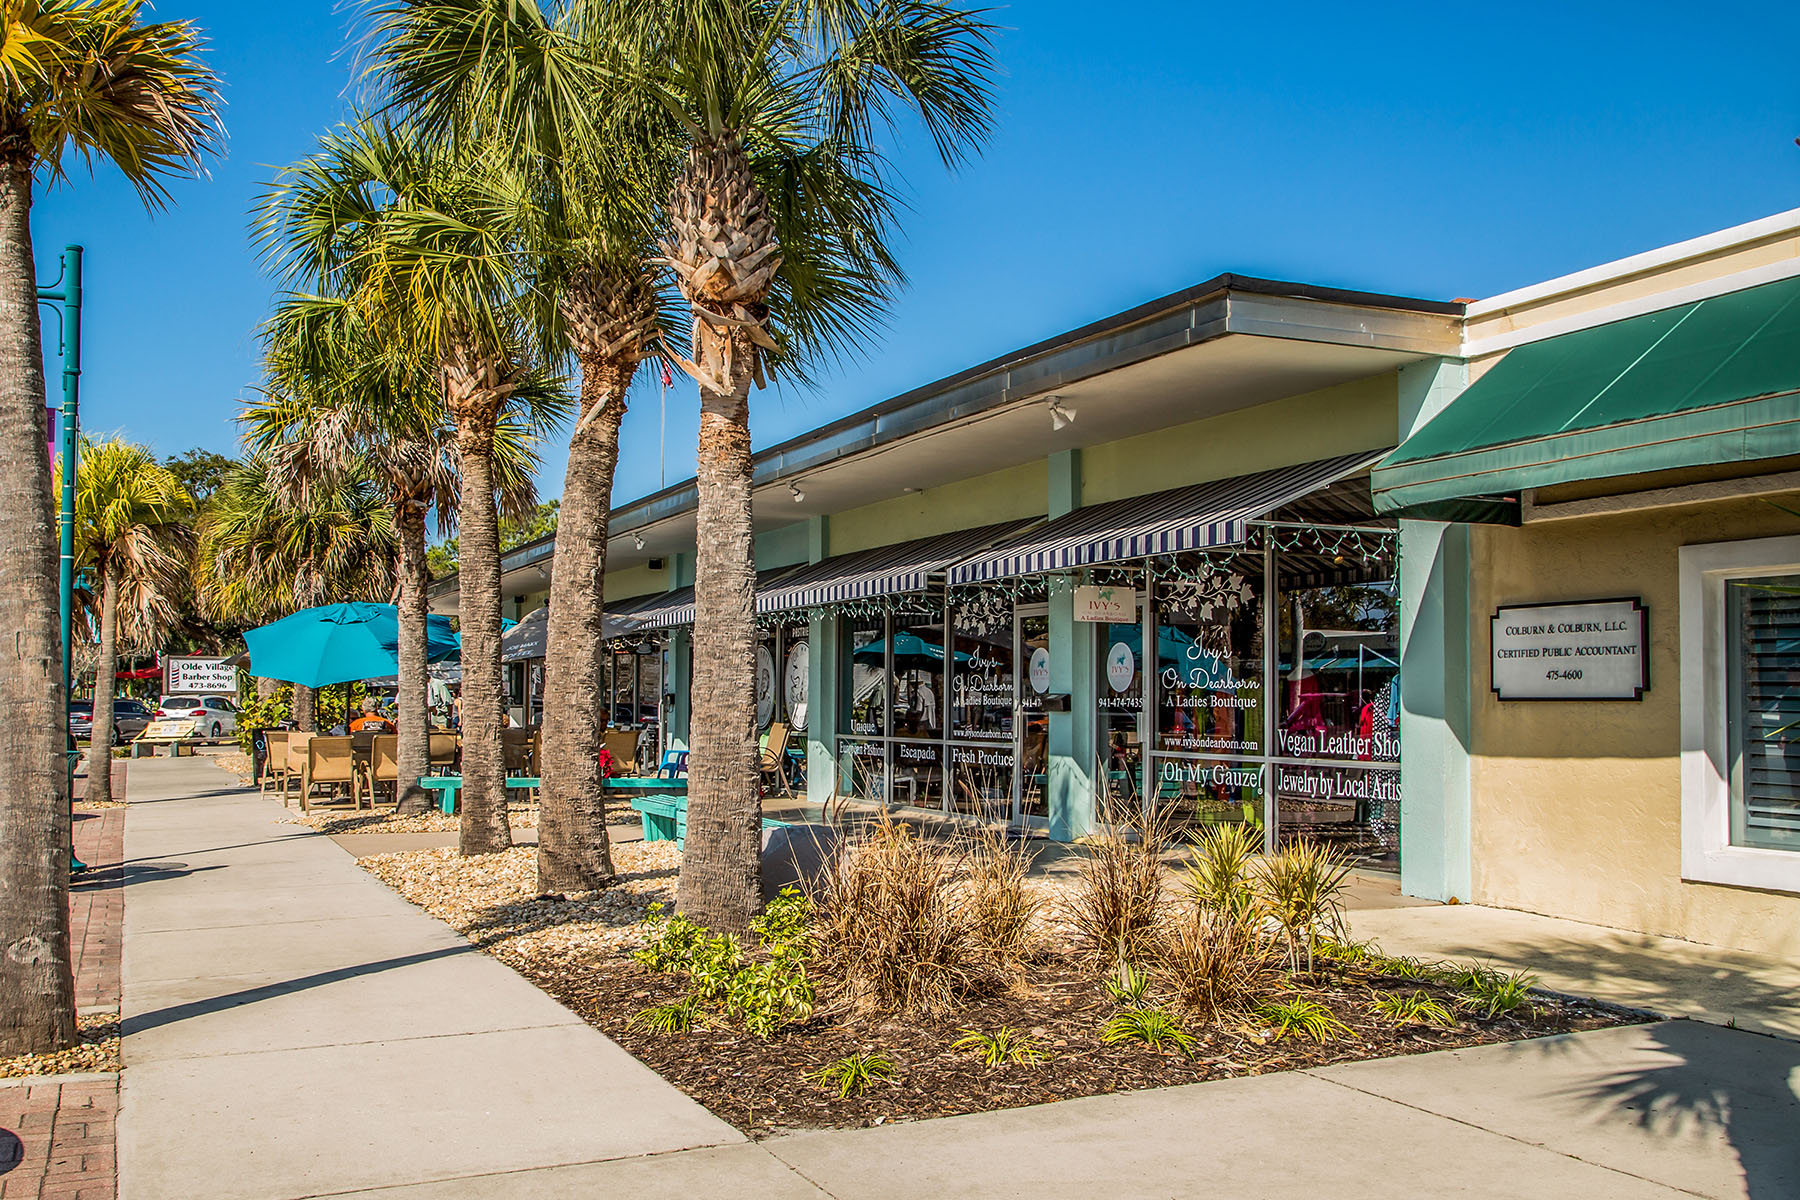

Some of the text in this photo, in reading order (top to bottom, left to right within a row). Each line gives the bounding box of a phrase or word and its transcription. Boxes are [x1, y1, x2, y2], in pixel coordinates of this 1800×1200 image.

[1505, 620, 1628, 637] COLBURN & COLBURN, L.L.C.
[1186, 630, 1233, 675] Ivy's
[1497, 644, 1637, 660] CERTIFIED PUBLIC ACCOUNTANT
[181, 663, 234, 672] Olde Village
[968, 644, 998, 681] Ivy's
[212, 672, 233, 682] Shop
[970, 673, 1015, 692] Dearborn
[1162, 667, 1260, 690] On Dearborn
[1545, 669, 1583, 681] 475-4600
[983, 695, 1013, 708] Boutique
[1098, 697, 1143, 708] 941-474-7435
[1166, 694, 1257, 710] A Ladies Boutique
[850, 719, 876, 736] Unique
[1164, 735, 1259, 751] www.ivysondearborn.com
[1277, 728, 1317, 757] Vegan
[1319, 728, 1371, 756] Leather
[900, 744, 936, 762] Escapada
[952, 748, 1015, 767] Fresh Produce
[1164, 761, 1184, 782] Oh
[1187, 762, 1209, 788] My
[1277, 767, 1319, 800] Jewelry
[1320, 770, 1334, 800] by
[1336, 771, 1370, 799] Local
